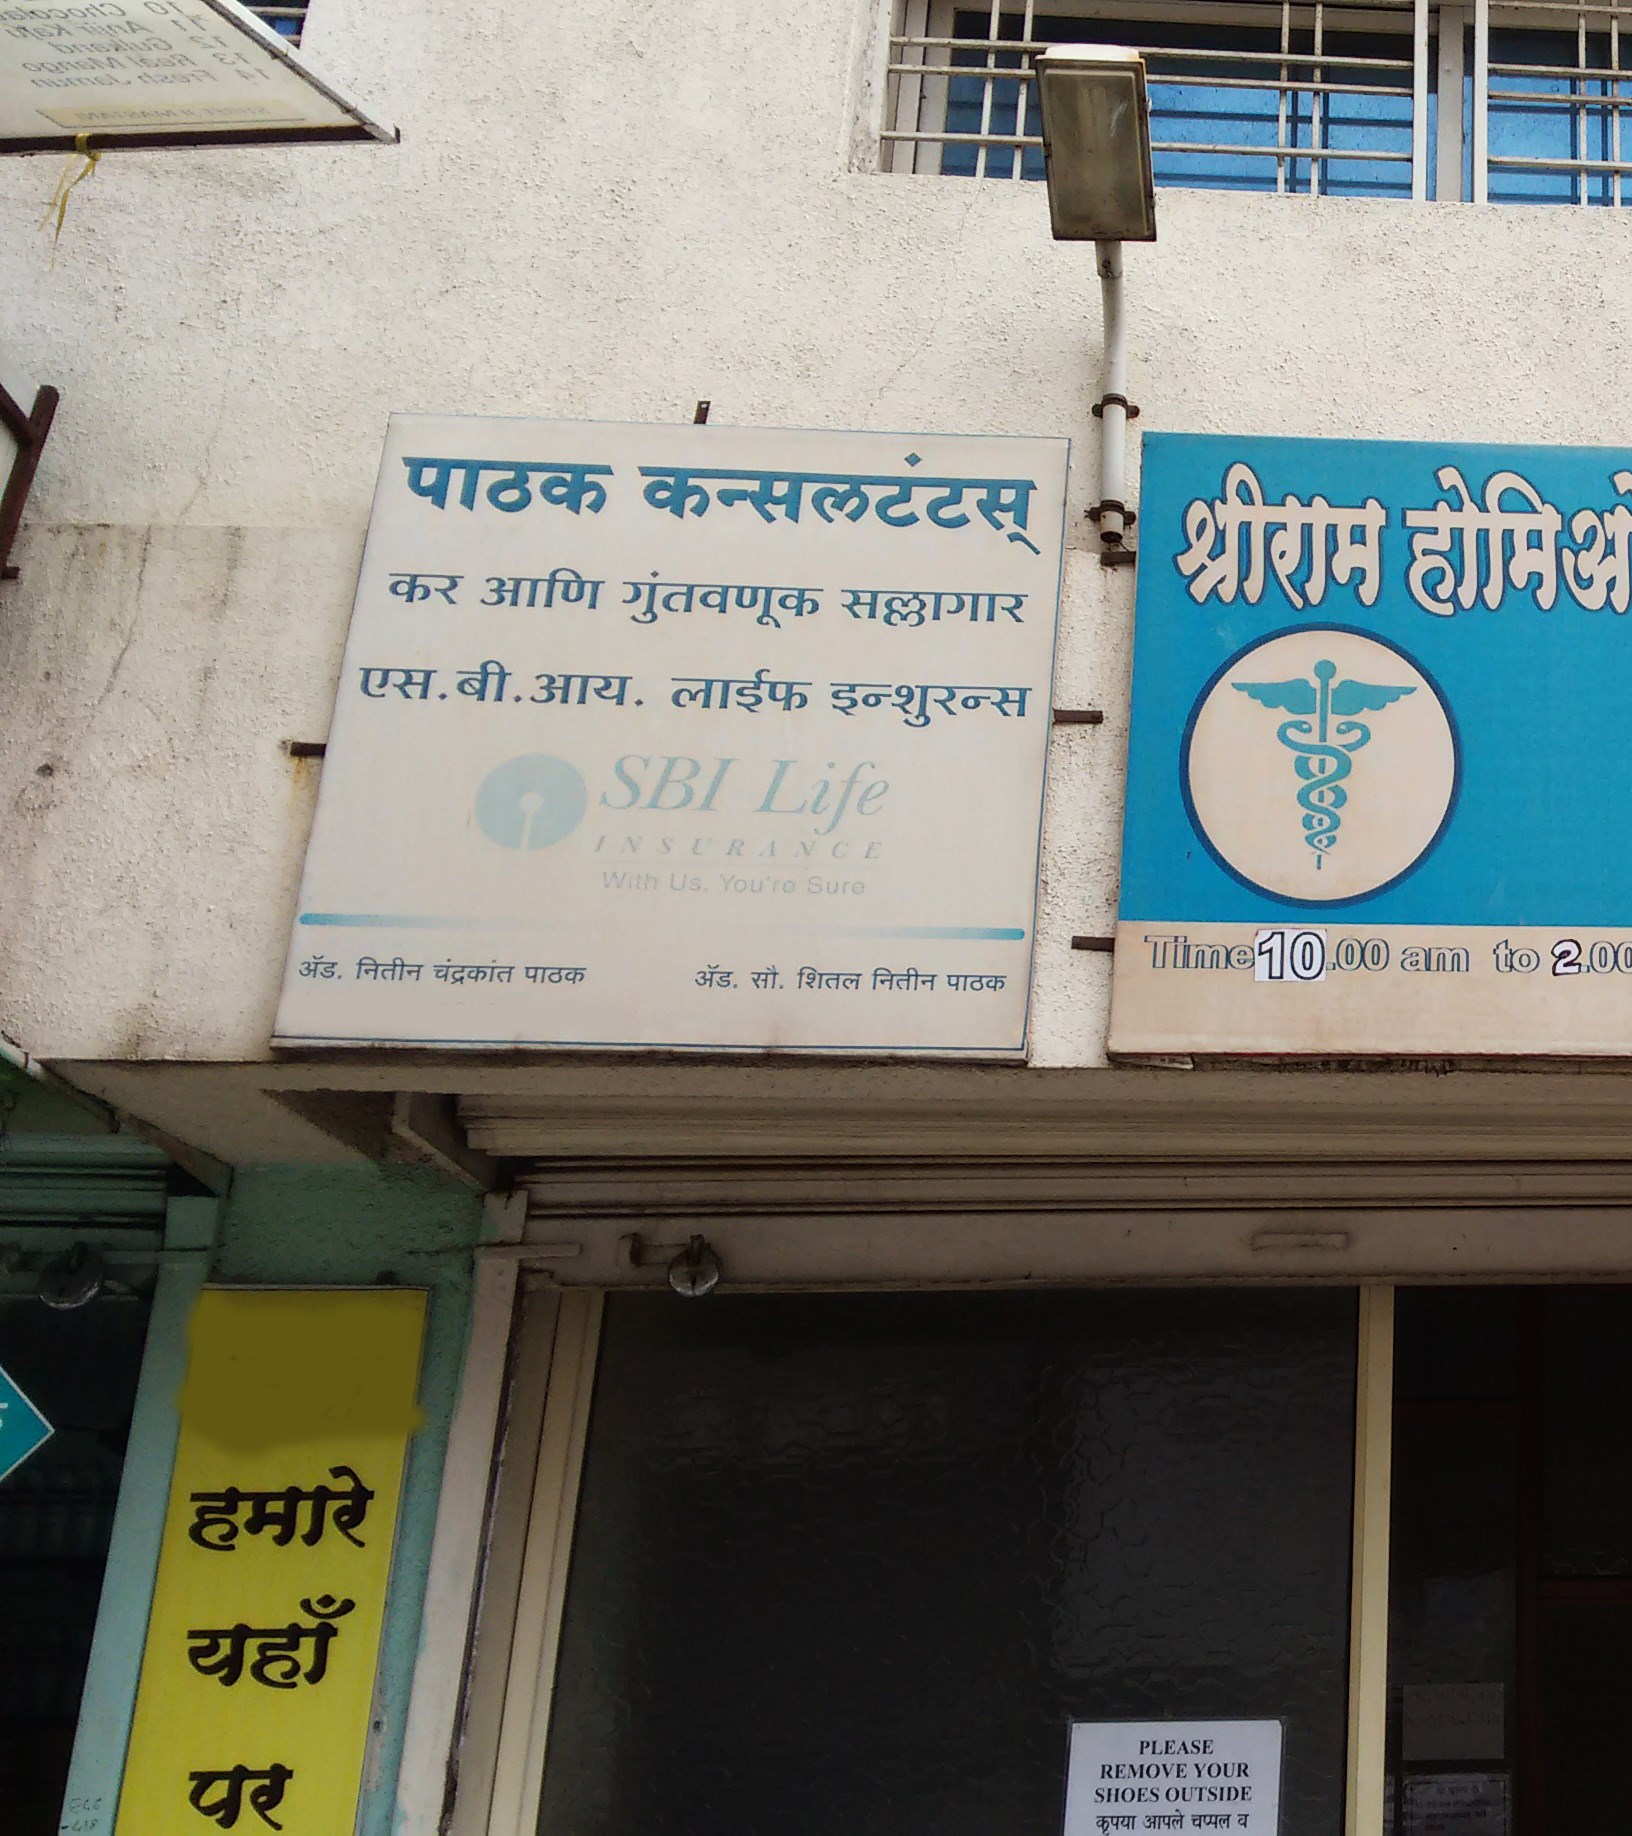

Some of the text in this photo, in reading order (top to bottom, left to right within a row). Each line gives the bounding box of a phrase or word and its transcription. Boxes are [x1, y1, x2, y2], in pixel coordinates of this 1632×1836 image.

[401, 452, 1042, 556] पाठक कन्सलटंटस्
[1173, 461, 1389, 610] श्रीराम
[388, 568, 1029, 629] कर आणि गुंतवणूक सल्लागार
[670, 669, 812, 714] लाईफ
[830, 680, 1032, 728] इन्शुरन्स
[599, 754, 891, 835] SBI Life
[602, 870, 658, 889] With
[807, 876, 866, 895] Sure
[356, 956, 424, 982] नितीन
[433, 959, 515, 984] चंद्रकांत
[525, 966, 587, 984] पाठक
[750, 964, 784, 990] सौ.
[797, 966, 862, 991] शितल
[871, 967, 937, 991] नितीन
[946, 972, 1007, 992] पाठक
[1400, 941, 1470, 973] am
[1494, 939, 1540, 973] to
[188, 1466, 375, 1550] हमारे
[187, 1593, 356, 1689] यहाँ
[1139, 1739, 1214, 1755] PLEASE
[1100, 1762, 1249, 1779] REMOVE YOUR
[188, 1763, 294, 1831] पर
[1094, 1786, 1252, 1803] SHOES OUTSIDE
[1096, 1809, 1249, 1836] कृपया आपले चप्पल व
